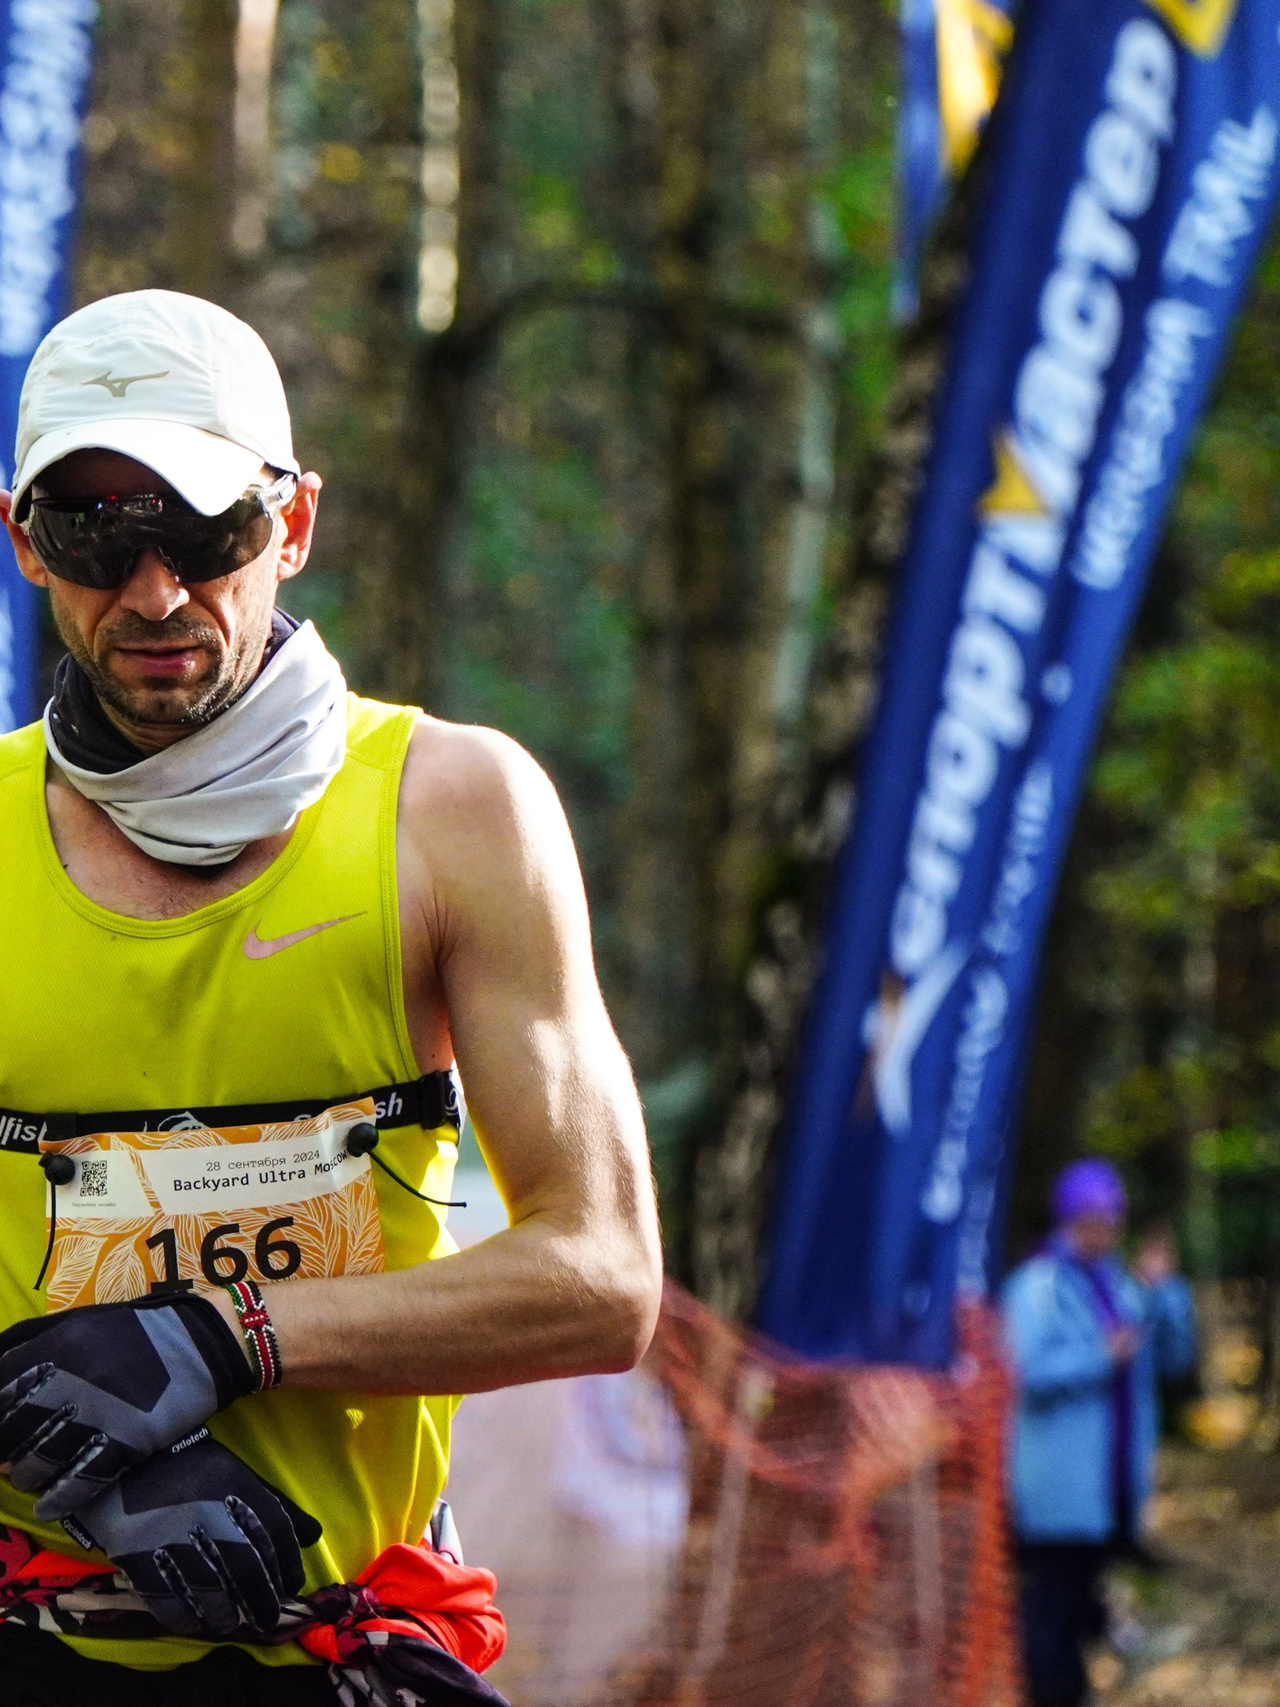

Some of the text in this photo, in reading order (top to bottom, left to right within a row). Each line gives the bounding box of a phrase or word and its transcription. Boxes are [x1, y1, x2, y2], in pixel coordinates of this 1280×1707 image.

[206, 1149, 320, 1173] 28 сентября 2024
[173, 1173, 250, 1192] Backyard
[259, 1166, 306, 1184] Ultra
[145, 1216, 302, 1291] 166
[171, 1427, 209, 1453] cyclotech
[62, 1519, 92, 1549] cyclotech
